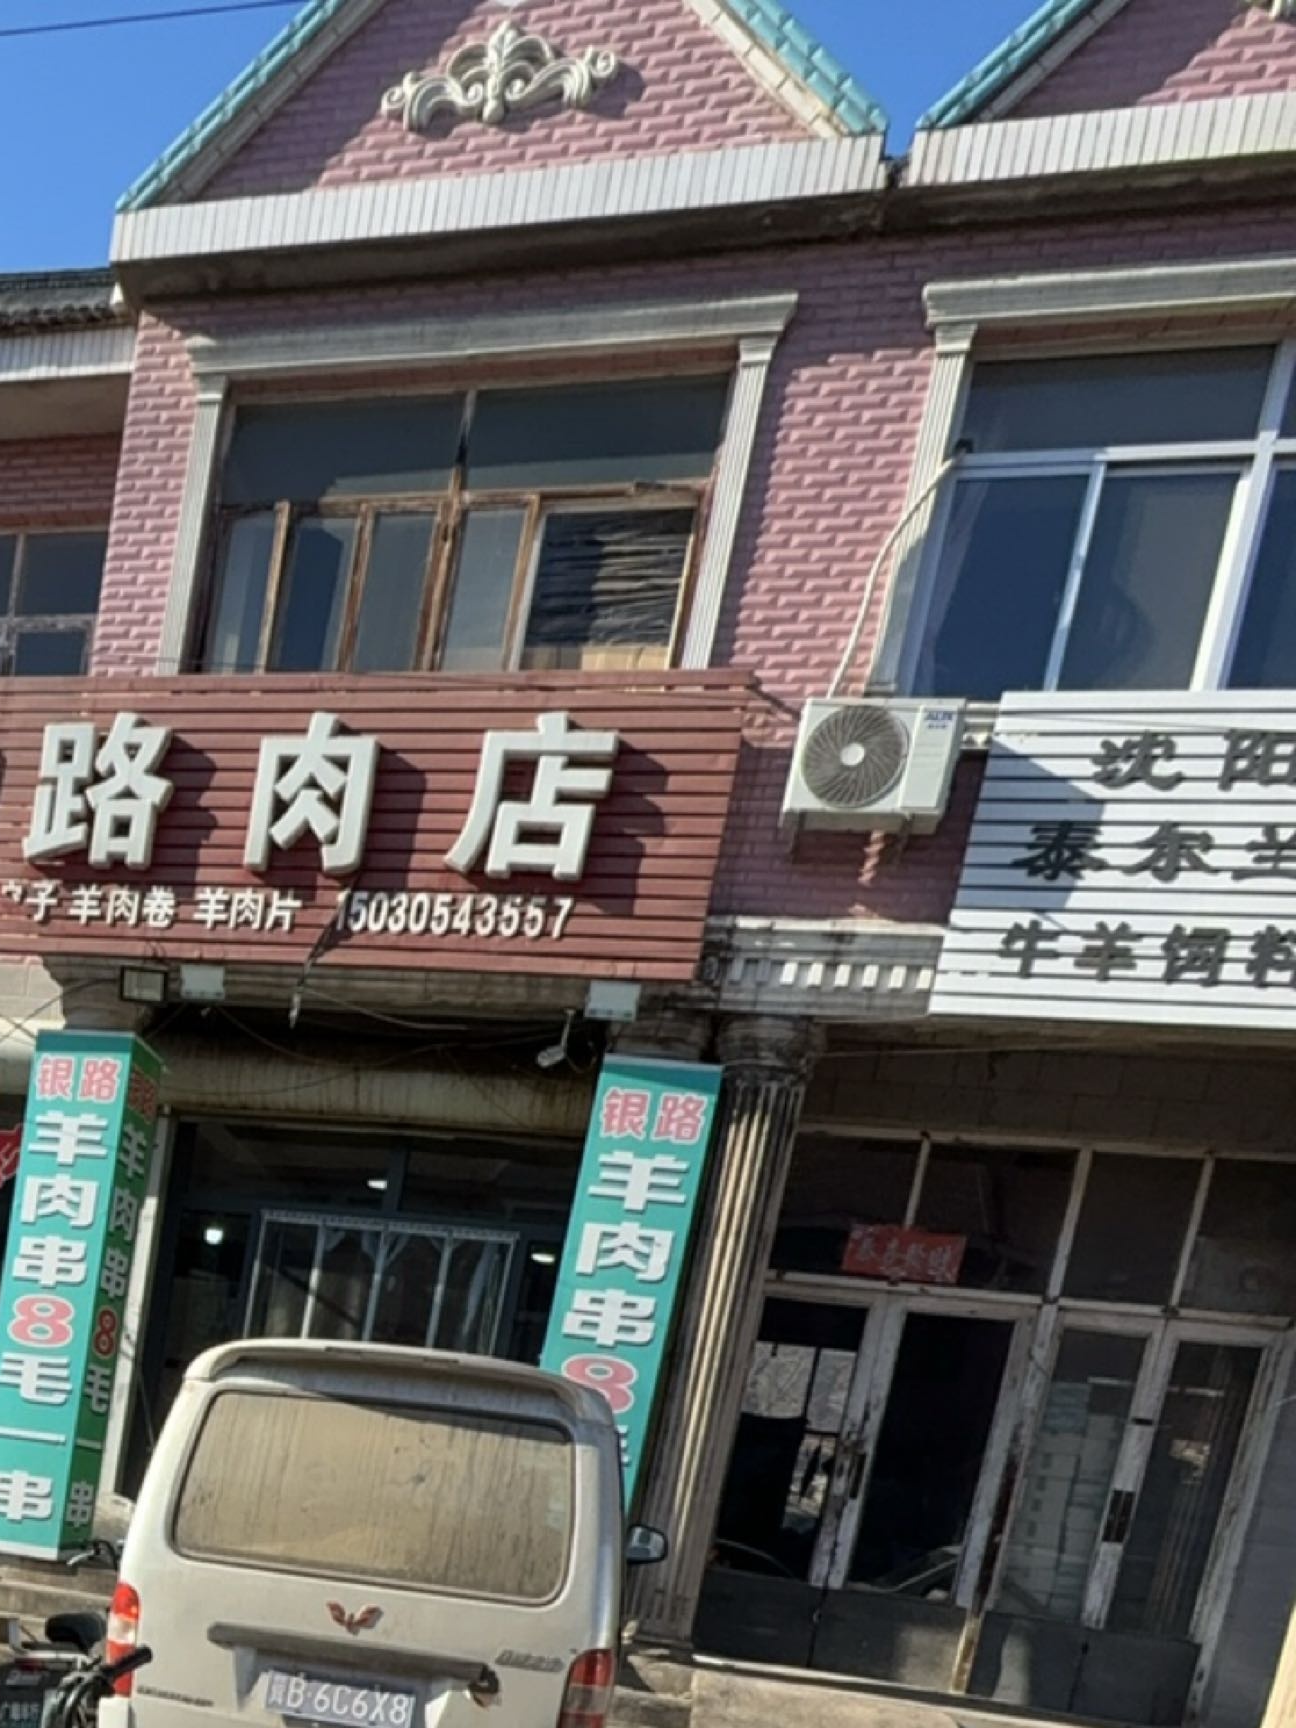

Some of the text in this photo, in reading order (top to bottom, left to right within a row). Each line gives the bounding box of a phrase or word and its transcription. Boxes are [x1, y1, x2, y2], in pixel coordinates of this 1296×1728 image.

[69, 883, 177, 929] 羊肉卷
[193, 886, 304, 932] 羊肉片
[35, 1054, 122, 1104] 银路
[600, 1086, 709, 1144] 银路
[561, 1150, 691, 1465] 羊肉串8
